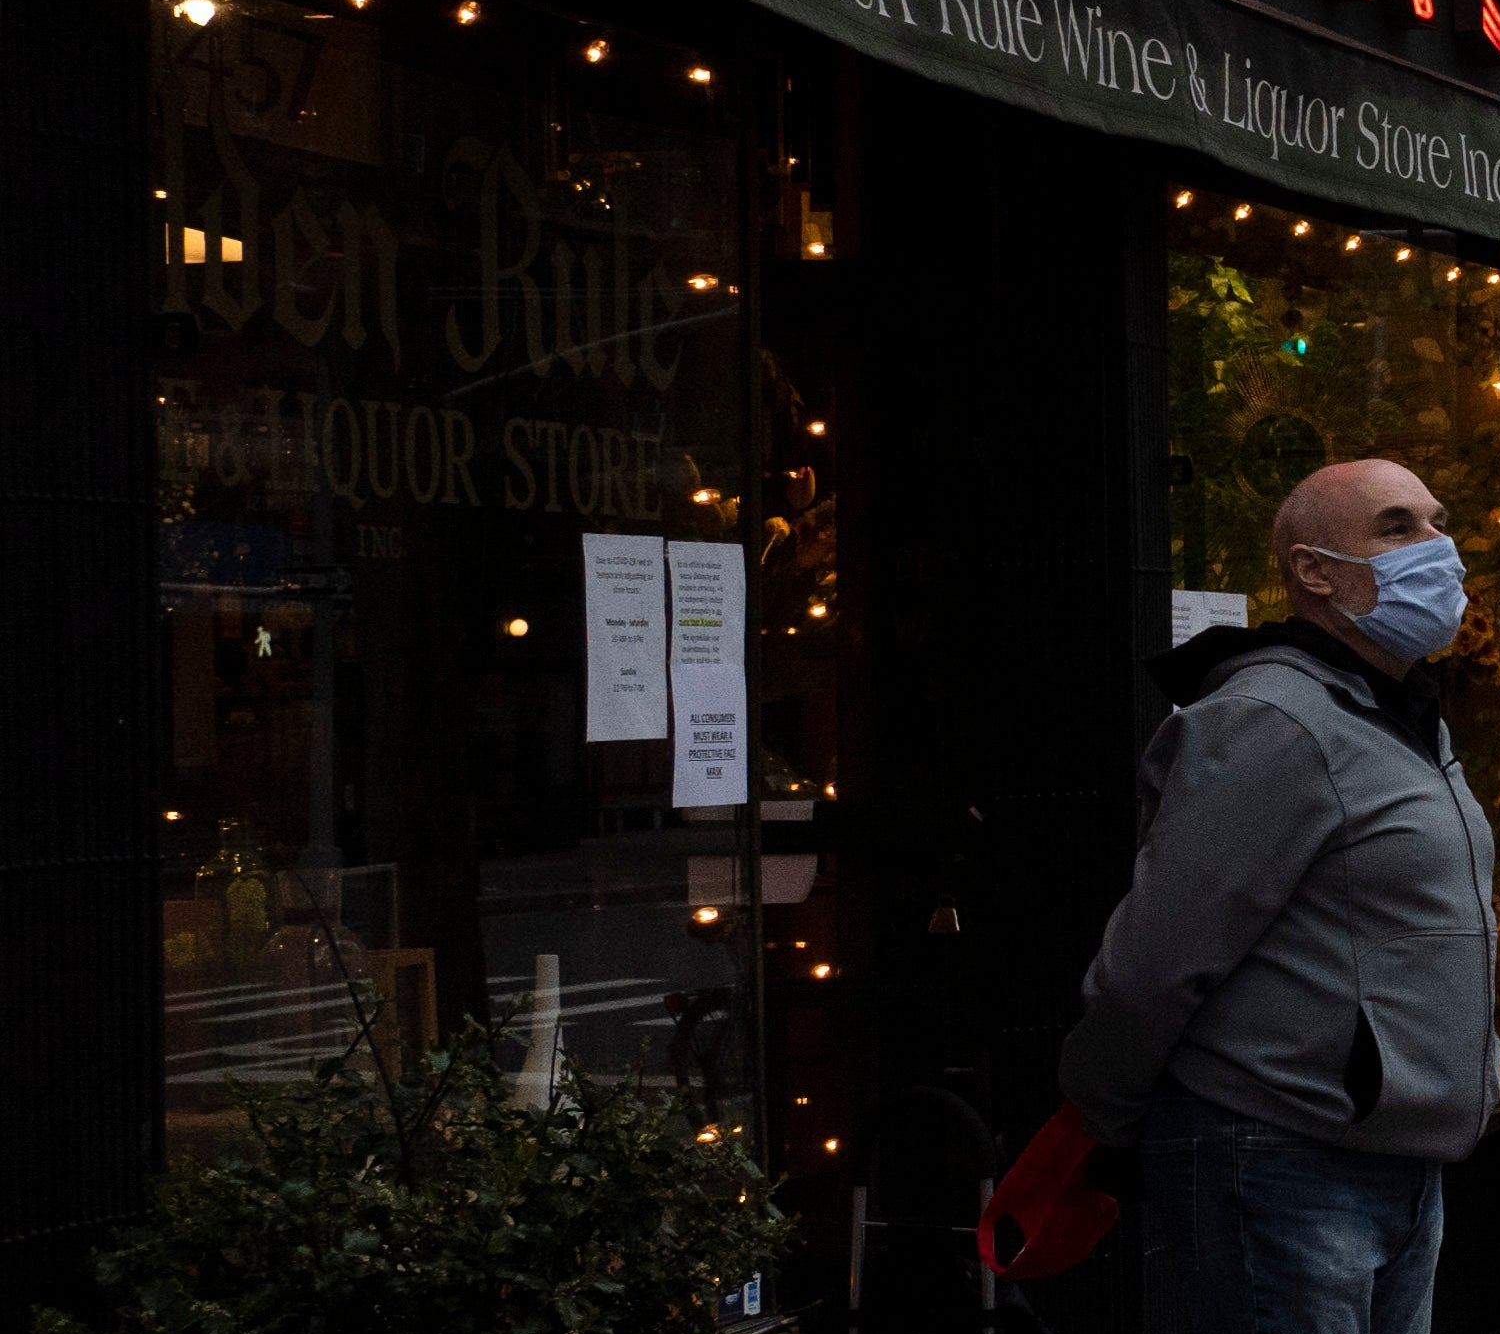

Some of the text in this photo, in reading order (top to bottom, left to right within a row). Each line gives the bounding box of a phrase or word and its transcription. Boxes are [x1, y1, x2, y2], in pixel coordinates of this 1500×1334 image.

[1186, 43, 1212, 115] &
[1223, 52, 1345, 160] Liquor
[1357, 101, 1452, 189] Store
[504, 416, 664, 522] STORE
